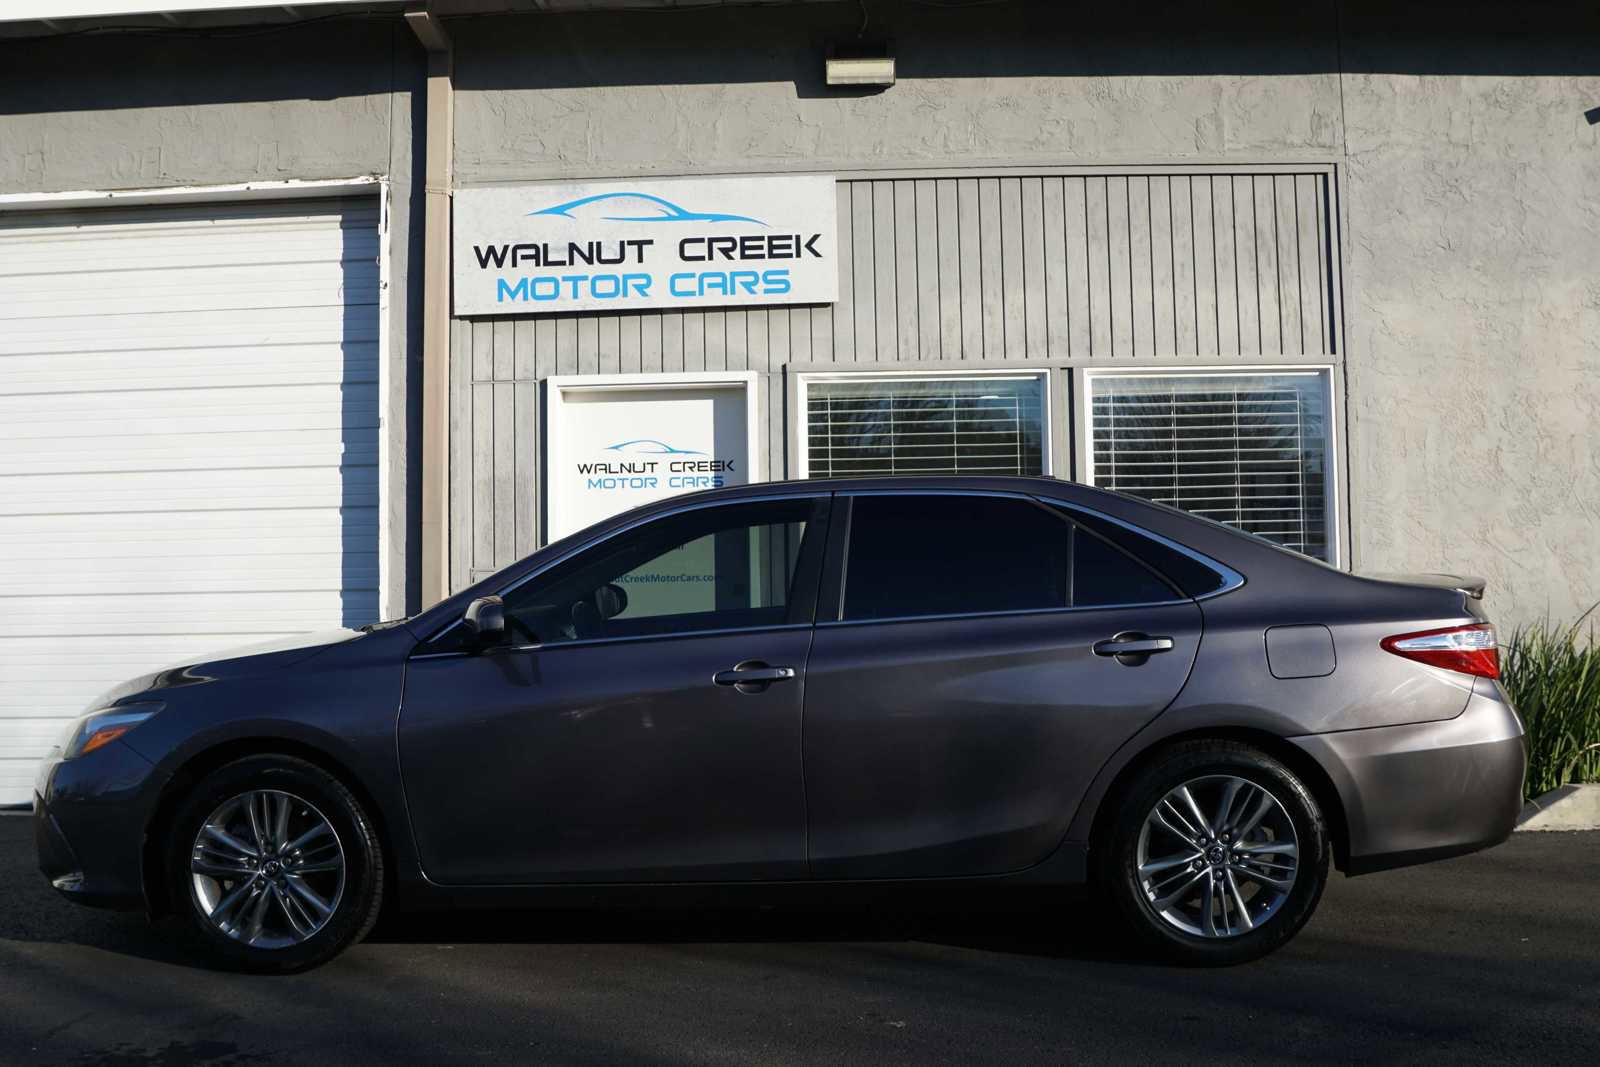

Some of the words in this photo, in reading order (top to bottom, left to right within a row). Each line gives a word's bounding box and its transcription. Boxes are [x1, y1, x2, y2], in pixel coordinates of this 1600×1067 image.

[473, 239, 654, 269] WALNUT
[678, 233, 824, 262] CREEK
[496, 273, 652, 303] MOTOR
[669, 269, 792, 297] CARS
[577, 462, 659, 475] WALNUT
[669, 460, 735, 473] CREEK
[587, 477, 658, 490] MOTOR
[668, 475, 724, 488] CARS
